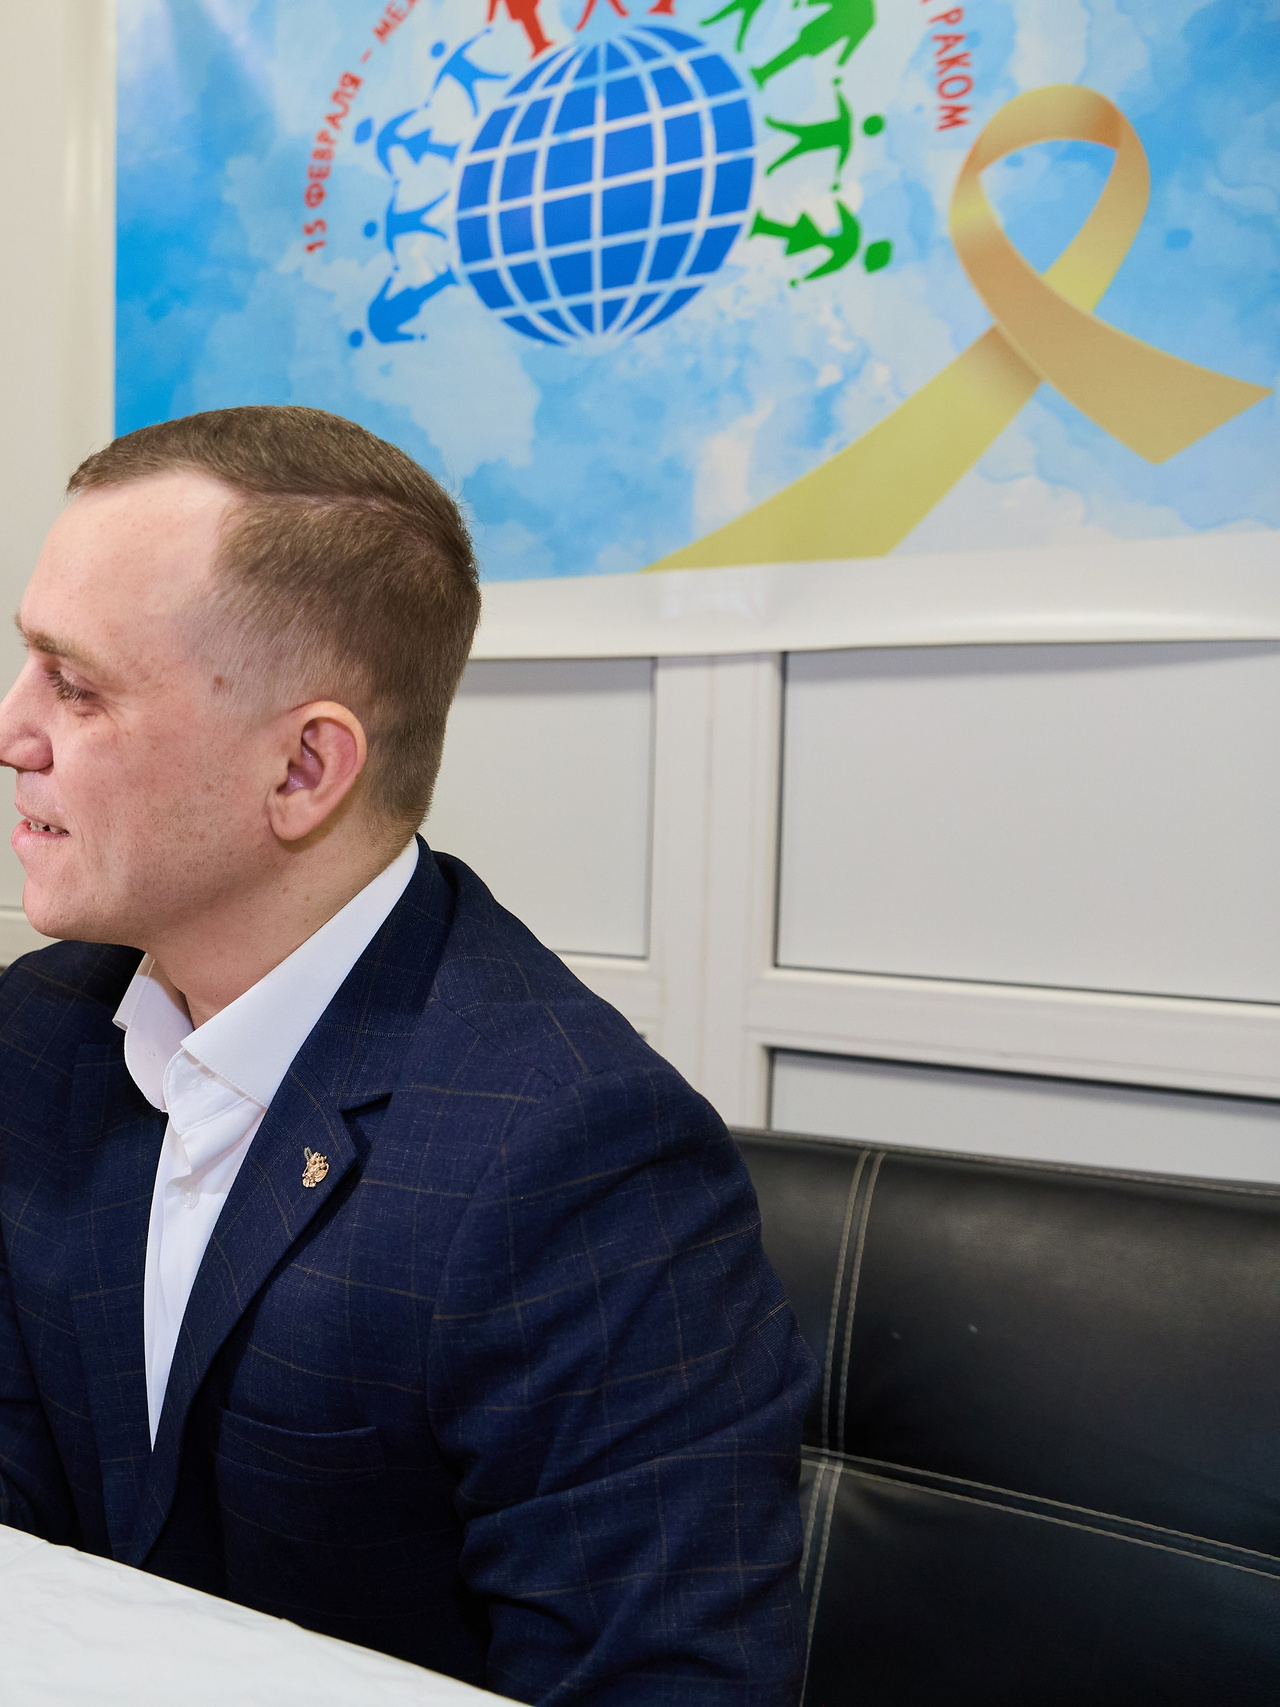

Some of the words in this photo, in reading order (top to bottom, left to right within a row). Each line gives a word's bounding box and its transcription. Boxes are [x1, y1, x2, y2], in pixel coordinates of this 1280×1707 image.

[373, 0, 419, 44] МЕ
[928, 6, 975, 132] РАКОМ
[303, 70, 364, 209] ФЕВРАЛЯ
[303, 217, 327, 254] 15
